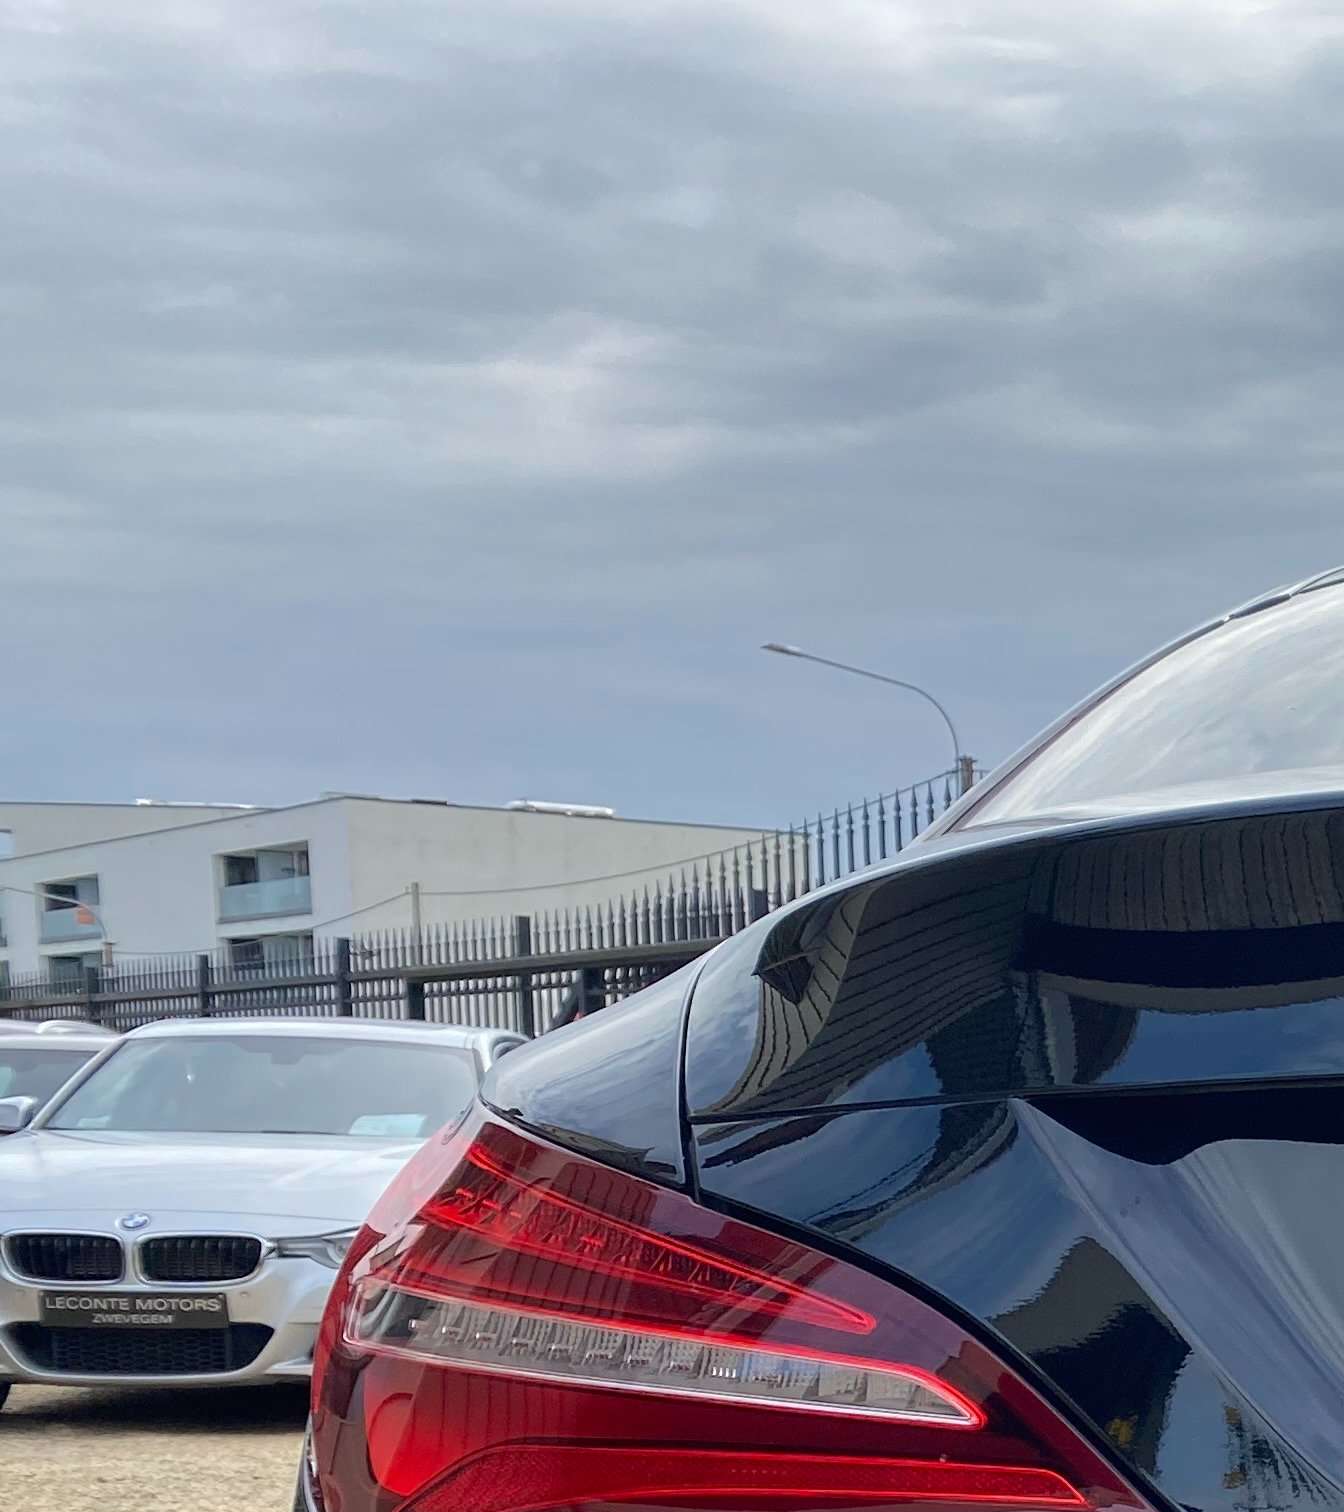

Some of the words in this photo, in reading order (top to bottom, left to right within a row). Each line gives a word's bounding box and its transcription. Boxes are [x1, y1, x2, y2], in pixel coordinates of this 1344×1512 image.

[45, 1297, 130, 1310] LECONTE
[135, 1298, 221, 1311] MOTORS
[92, 1313, 175, 1324] ZWEVEGEM
